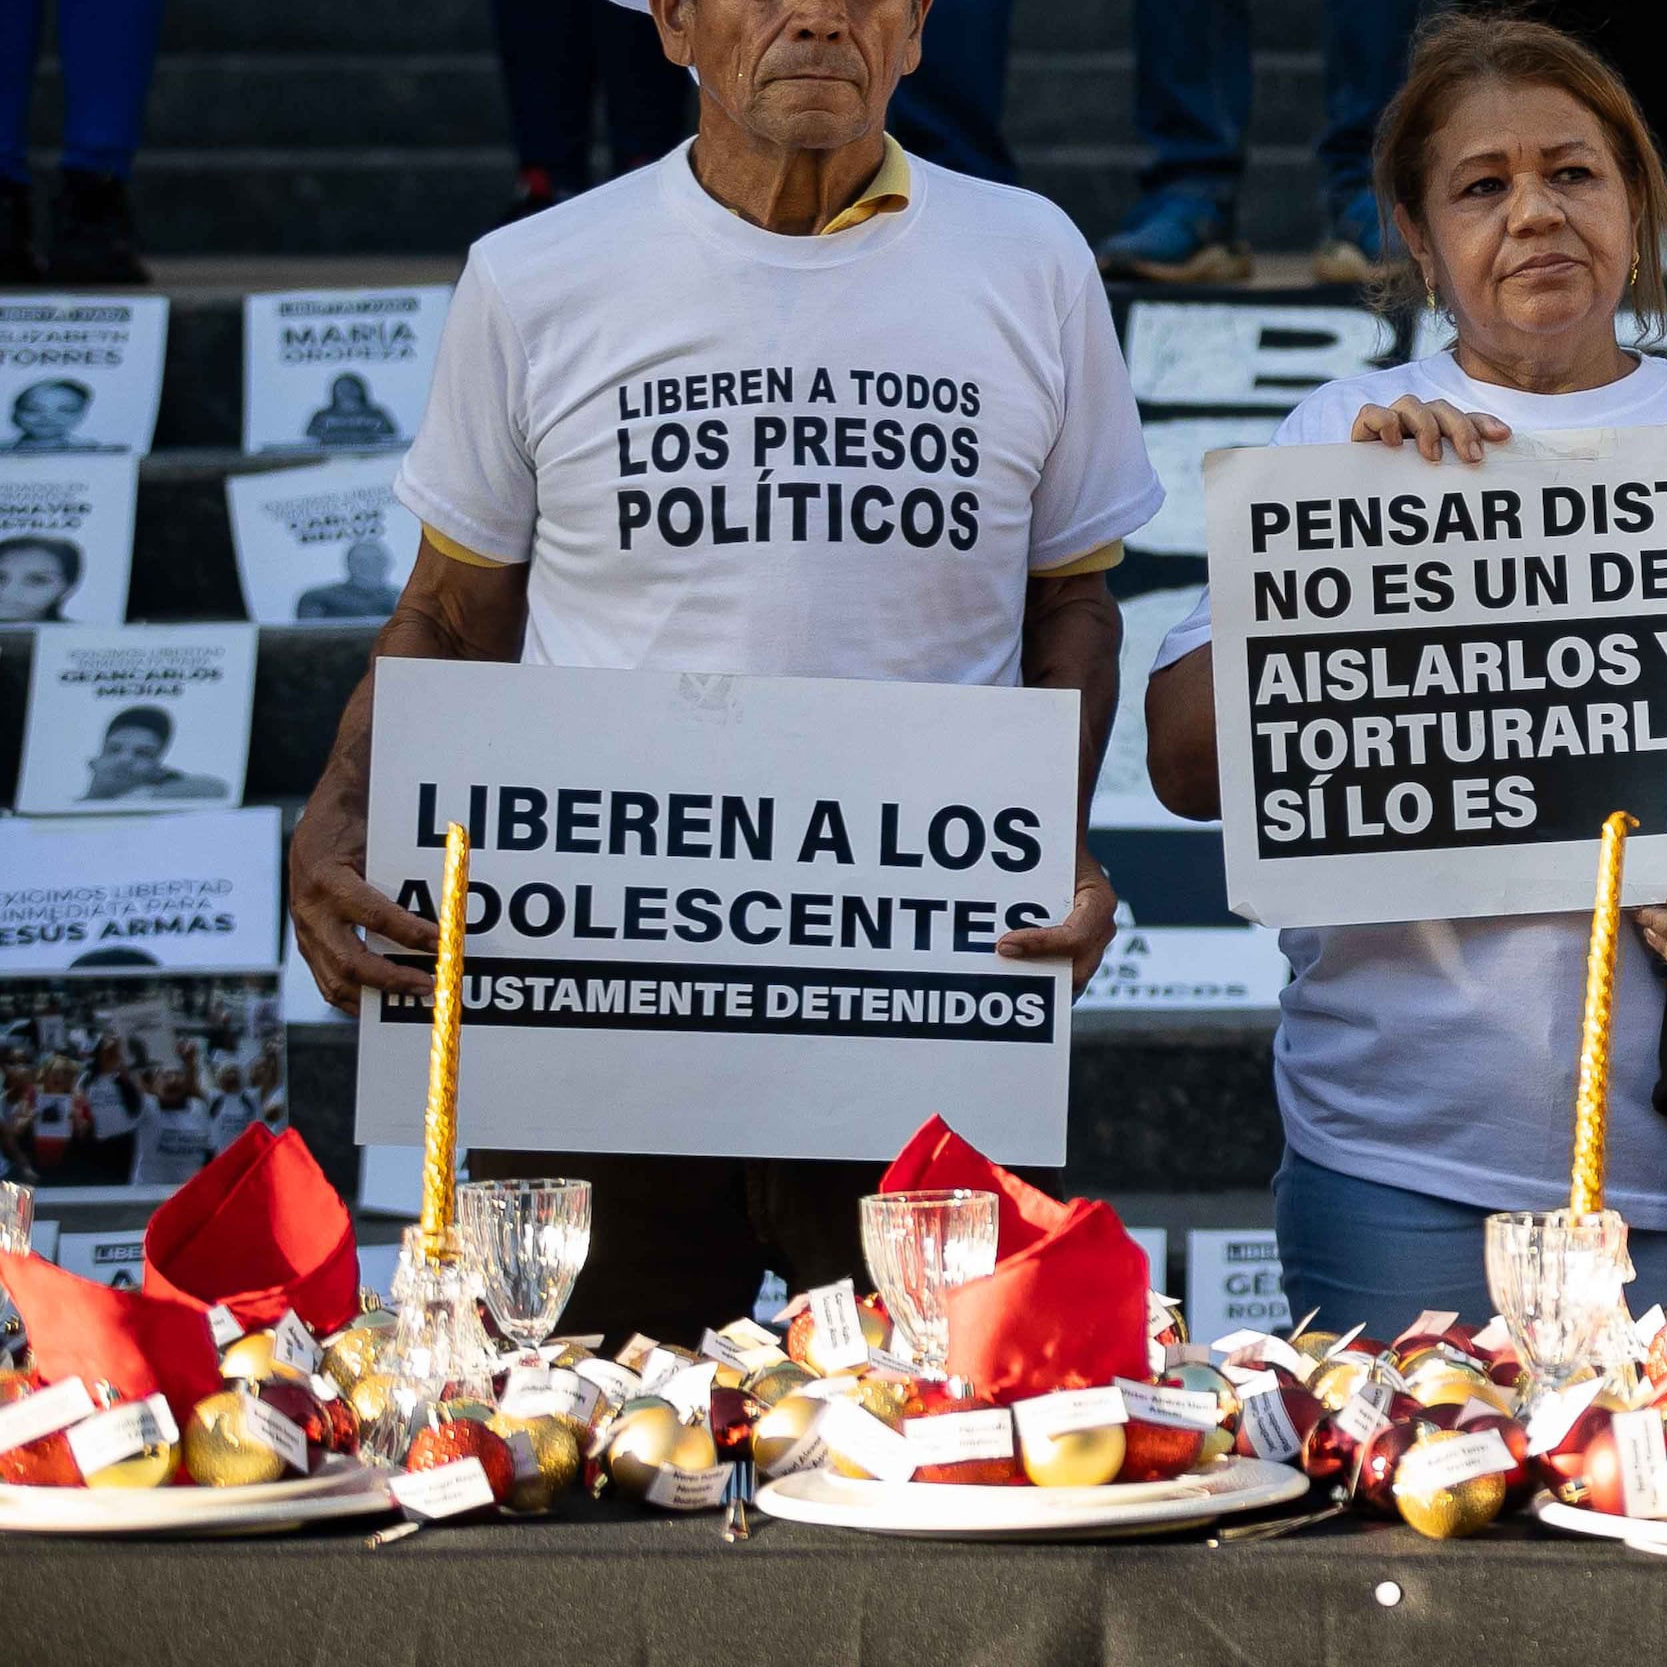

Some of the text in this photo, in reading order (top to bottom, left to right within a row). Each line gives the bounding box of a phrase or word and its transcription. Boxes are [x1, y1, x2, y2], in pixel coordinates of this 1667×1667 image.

[619, 365, 981, 422] LIBEREN A TODOS
[618, 415, 981, 479] LOS PRESOS
[618, 468, 981, 553] POLÍTICOS
[1250, 487, 1523, 554] PENSAR
[1253, 566, 1352, 623] NO
[1371, 561, 1455, 615] ES
[1473, 554, 1568, 610] UN
[1255, 632, 1642, 706] AISLARLOS
[416, 781, 1044, 874] LIBEREN A LOS
[1262, 773, 1537, 843] SÍ LO ES
[99, 913, 237, 940] ARMAS
[765, 984, 1047, 1029] DETENIDOS
